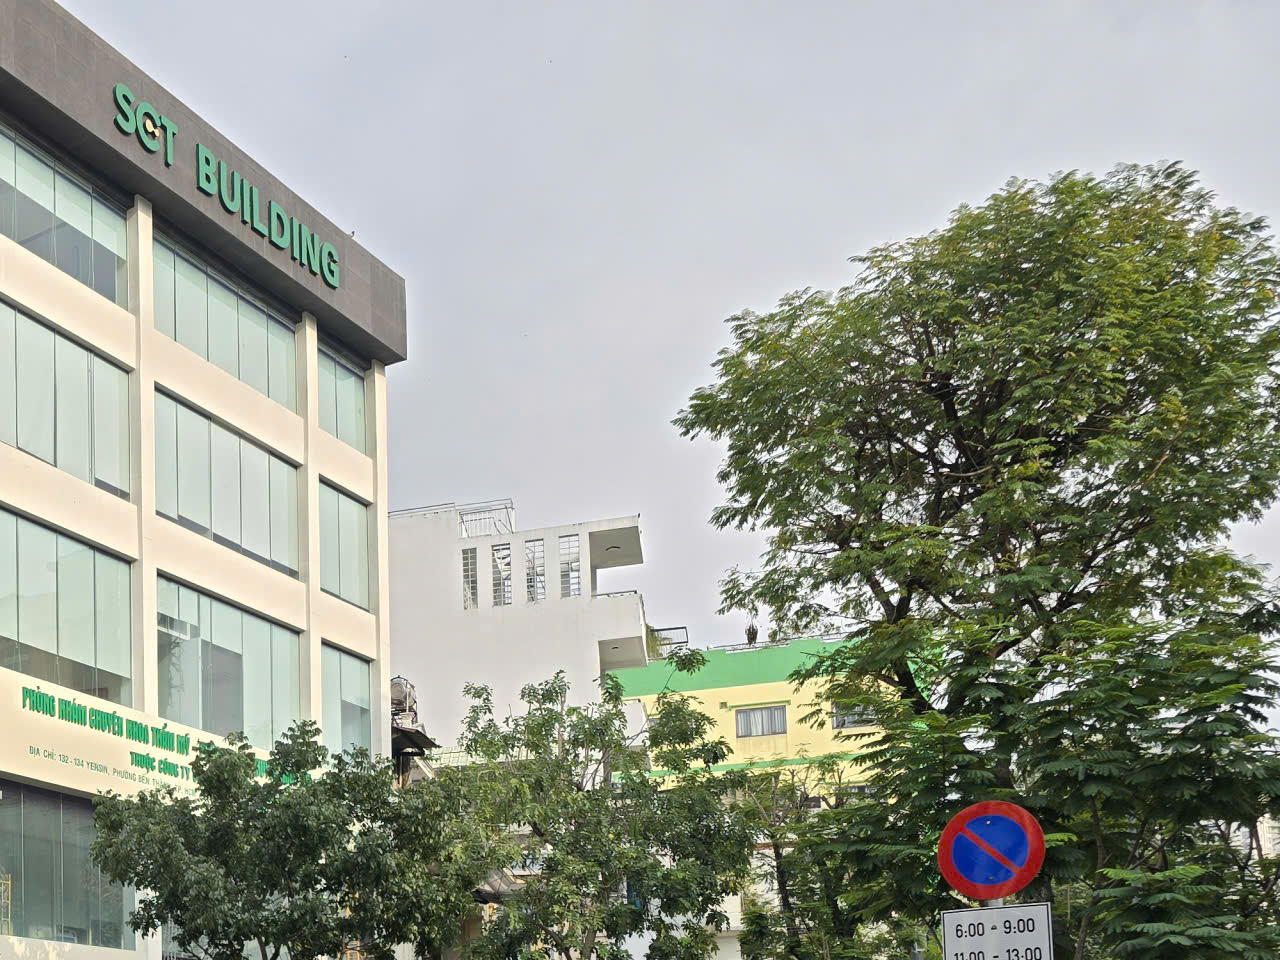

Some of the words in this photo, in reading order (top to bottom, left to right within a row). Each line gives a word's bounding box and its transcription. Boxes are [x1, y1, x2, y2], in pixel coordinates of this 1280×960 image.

[196, 143, 340, 289] BUILDING
[58, 753, 69, 764] 132
[74, 758, 84, 769] 134
[955, 922, 985, 938] 6:00
[1003, 918, 1035, 934] 9:00
